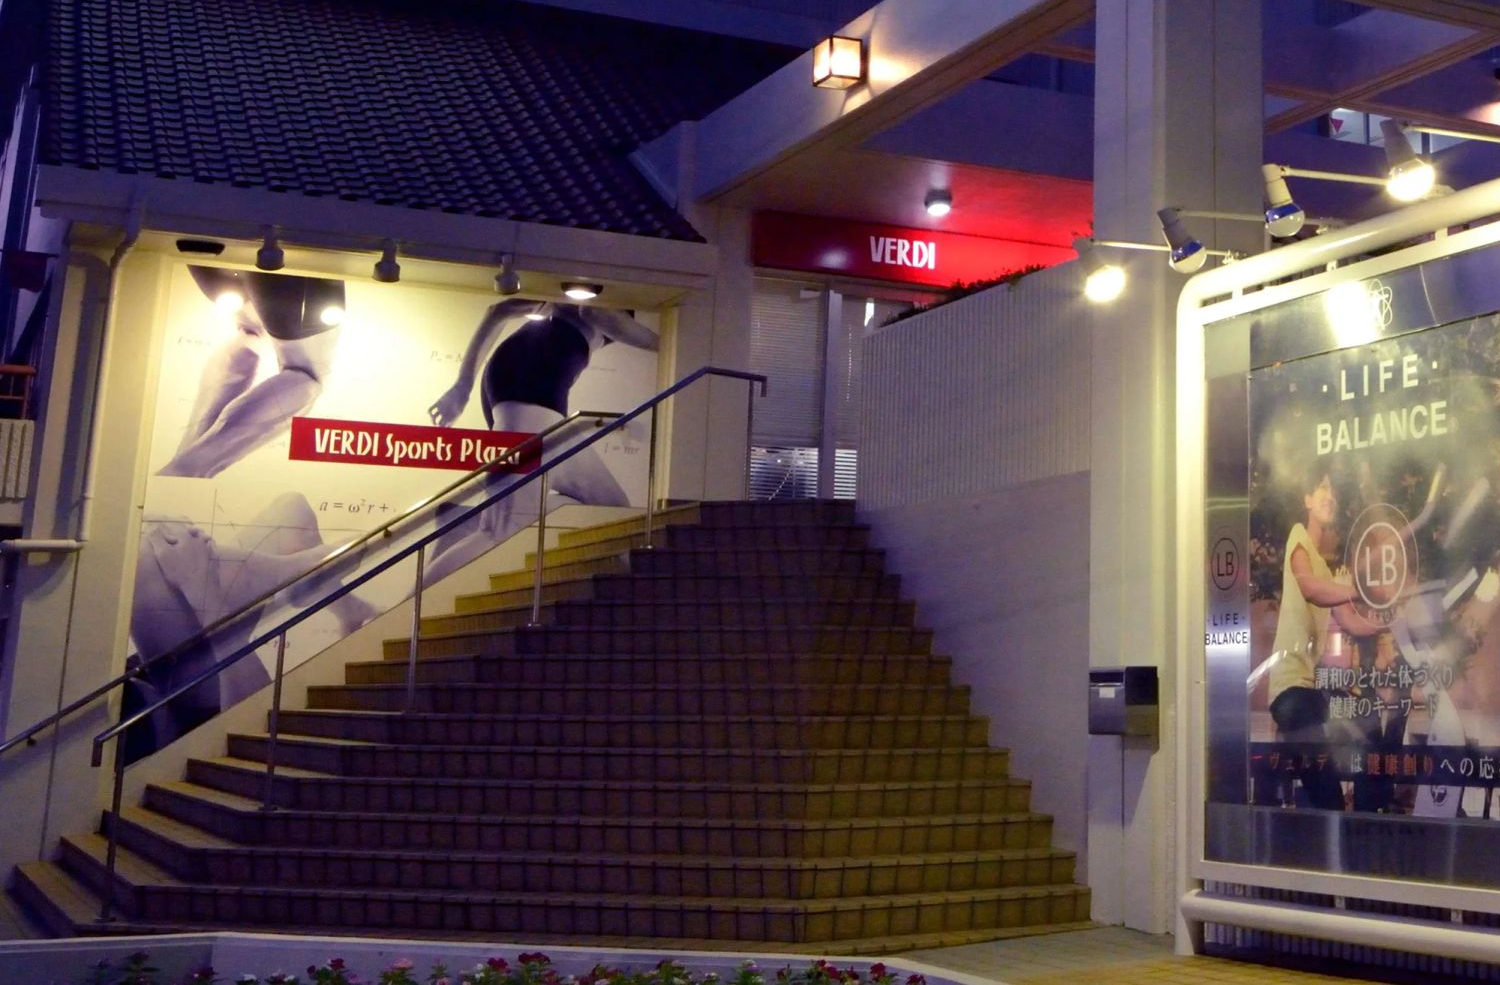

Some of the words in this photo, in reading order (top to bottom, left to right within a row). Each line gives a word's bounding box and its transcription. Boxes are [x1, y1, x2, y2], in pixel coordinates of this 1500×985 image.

[869, 235, 936, 271] VERDI
[1316, 400, 1448, 456] BALANCE
[314, 427, 379, 457] VERDI
[385, 432, 453, 464] Sports
[1216, 551, 1235, 577] LB
[1365, 544, 1398, 587] LB
[1204, 631, 1248, 646] BALANCE
[1315, 665, 1454, 691] 調和のとれた体づくり
[1329, 694, 1439, 720] 健康のキーワード
